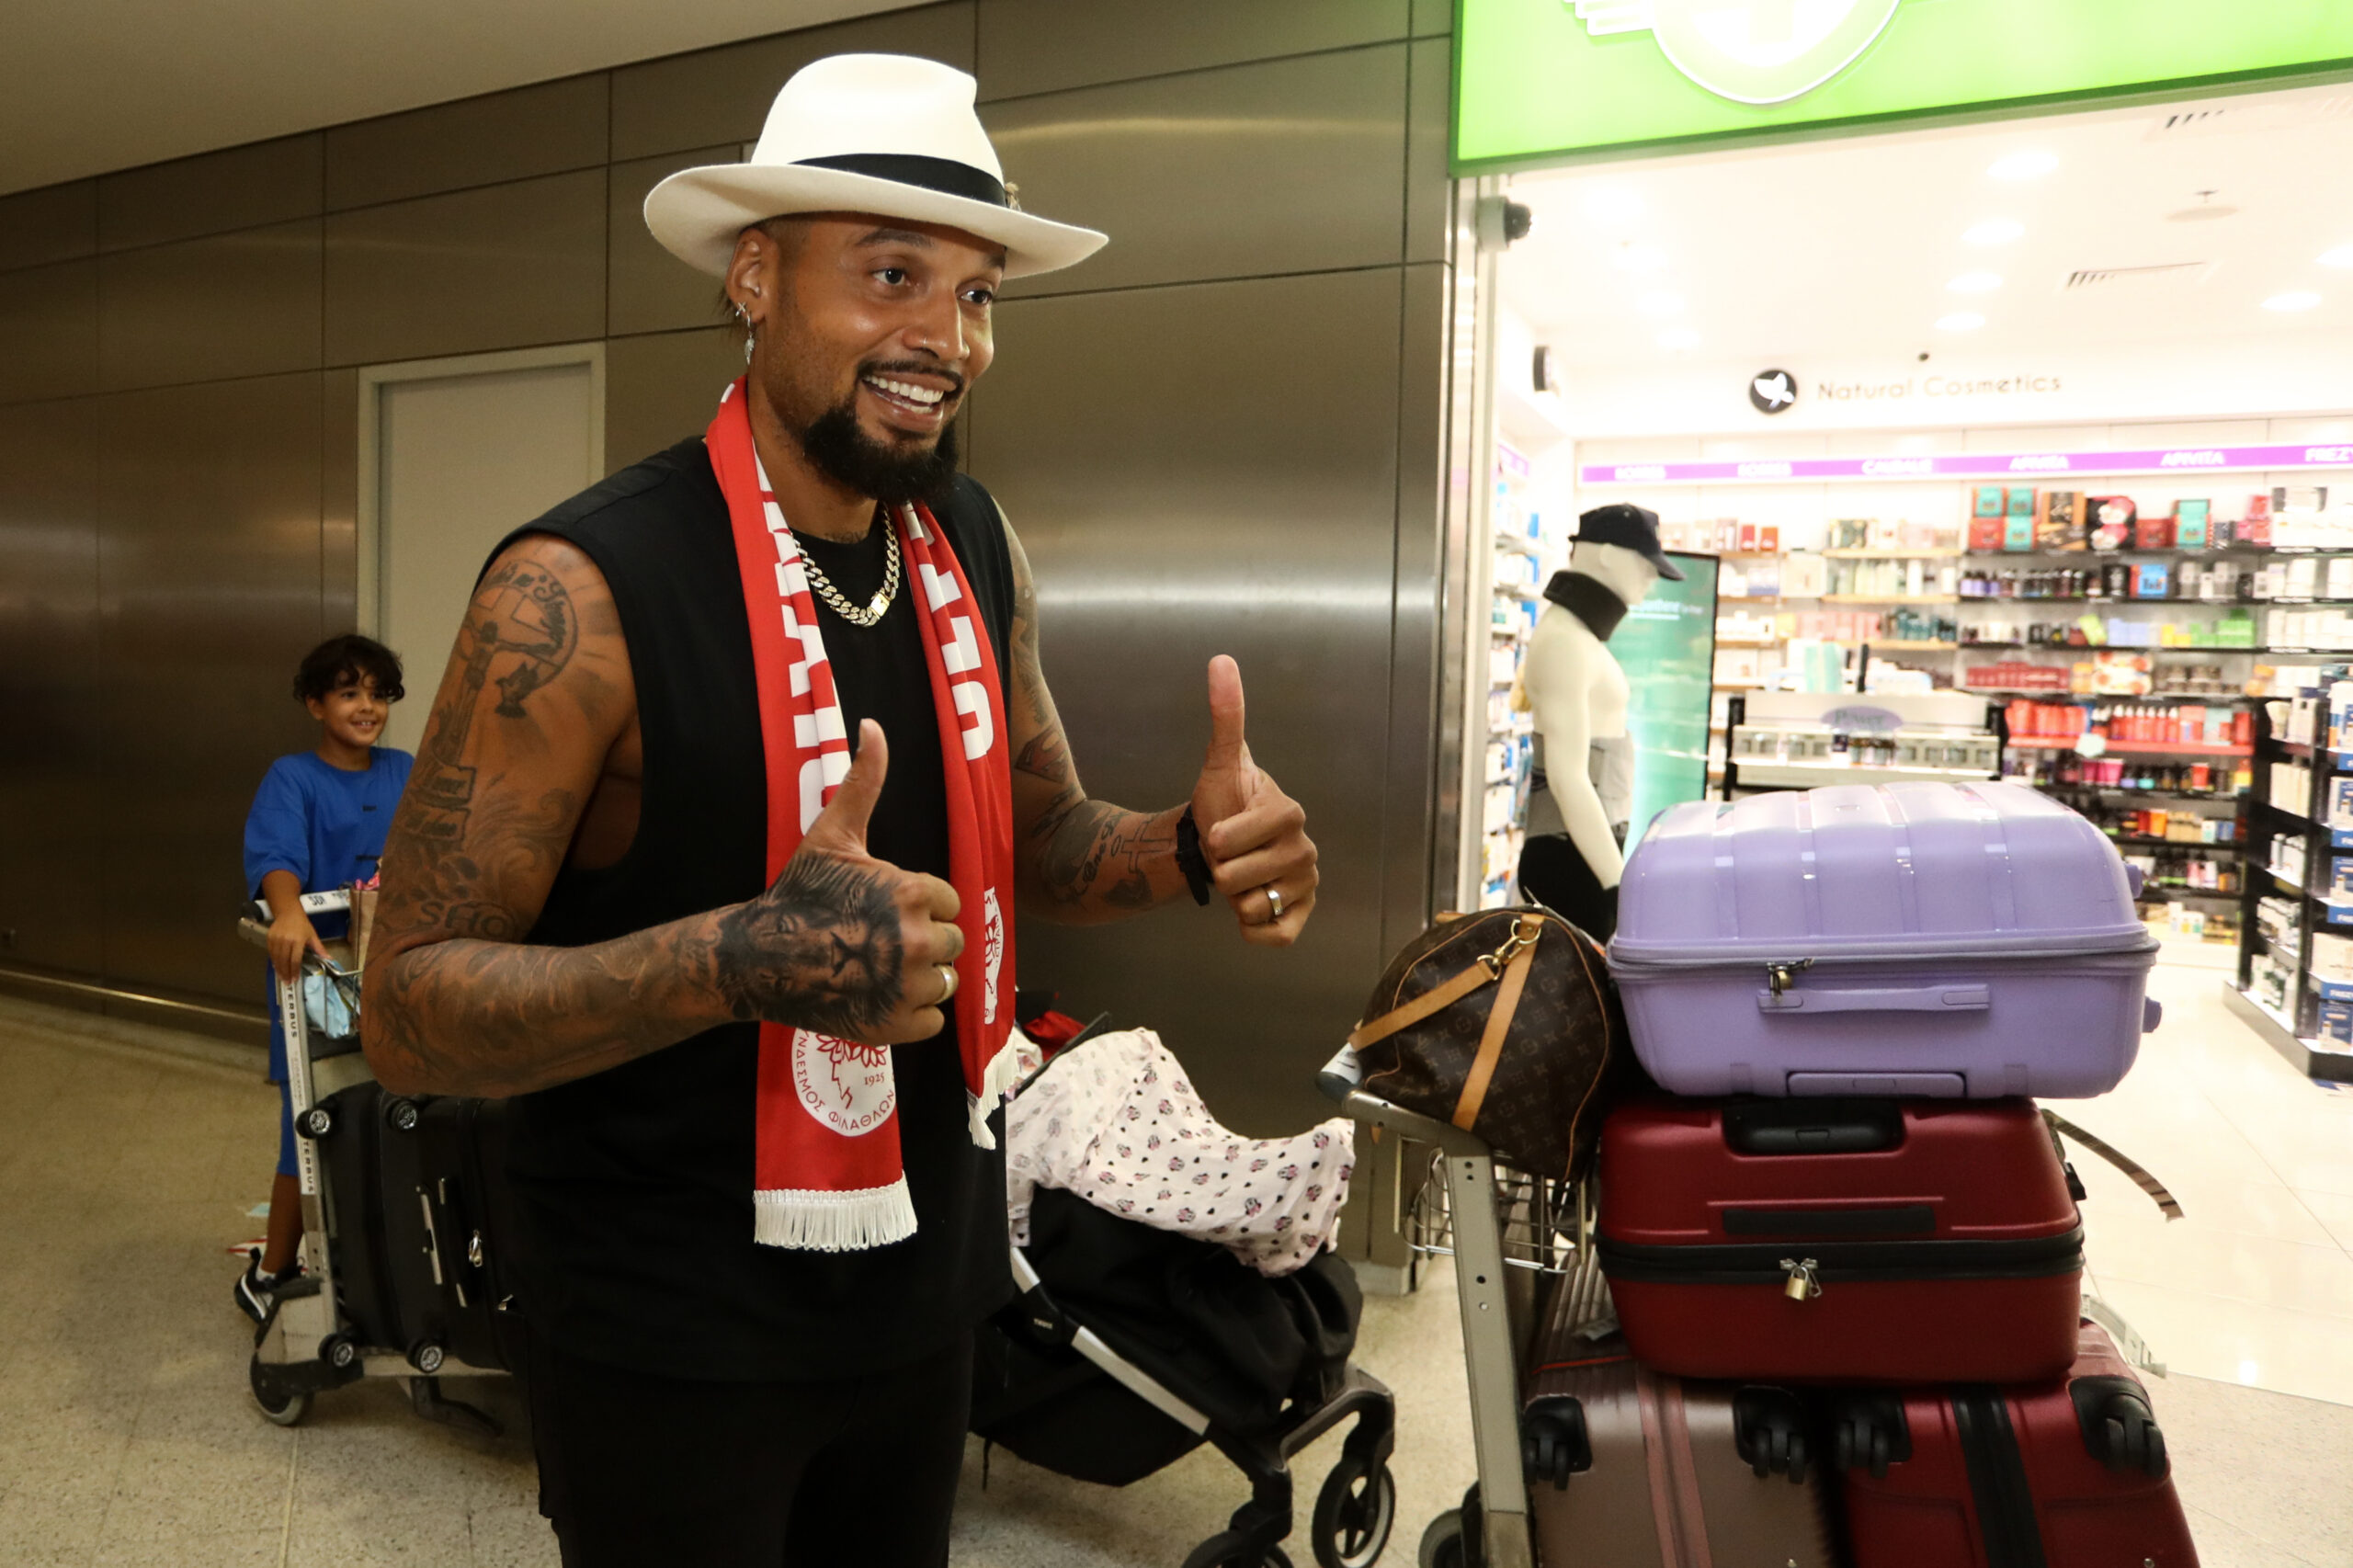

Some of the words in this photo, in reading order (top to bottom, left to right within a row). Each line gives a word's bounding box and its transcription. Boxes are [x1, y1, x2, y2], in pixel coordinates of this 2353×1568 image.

[1817, 378, 1913, 402] Natural
[1923, 372, 2063, 398] Cosmetics
[2159, 450, 2226, 467] APIVITA
[287, 984, 298, 1039] TERBUS
[864, 1072, 885, 1087] 1925
[828, 1089, 895, 1131] ΦΙΛΑΘΛΩΝ
